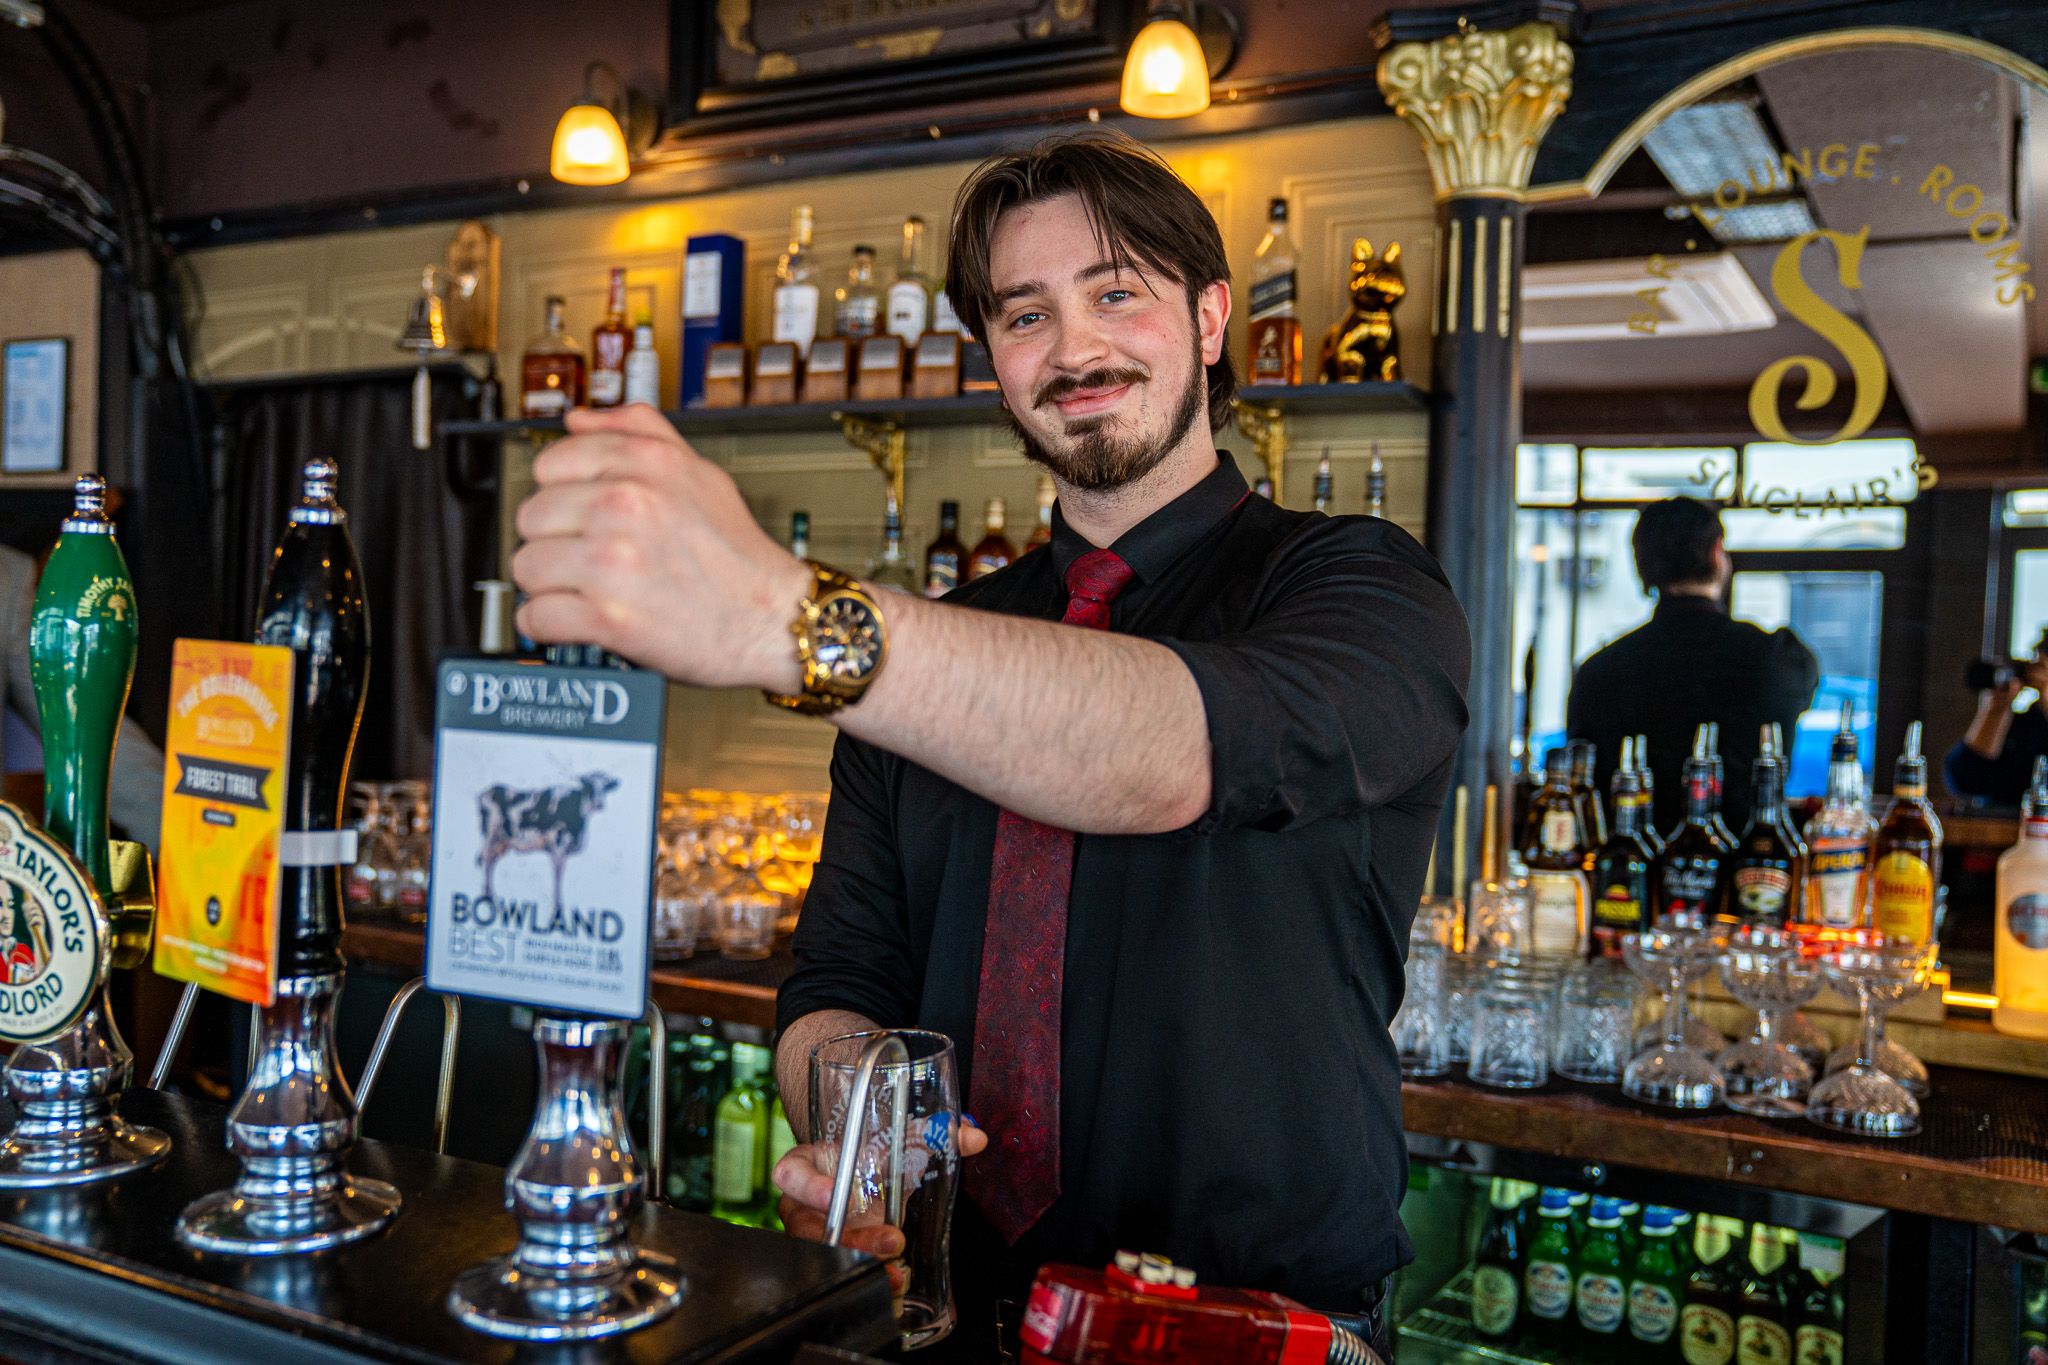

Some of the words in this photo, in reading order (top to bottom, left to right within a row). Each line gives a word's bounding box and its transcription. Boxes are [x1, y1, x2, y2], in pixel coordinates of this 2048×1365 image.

[1690, 143, 1881, 229] LOUNGE
[1919, 164, 2036, 307] ROOMS
[1748, 224, 1888, 445] S
[76, 576, 114, 619] TIMOTHY
[471, 672, 631, 726] BOWLAND
[501, 704, 589, 730] BREWERY
[185, 765, 226, 794] FOREST
[15, 841, 85, 953] TAYLOR'S
[451, 891, 625, 944] BOWLAND
[448, 924, 517, 964] BEST
